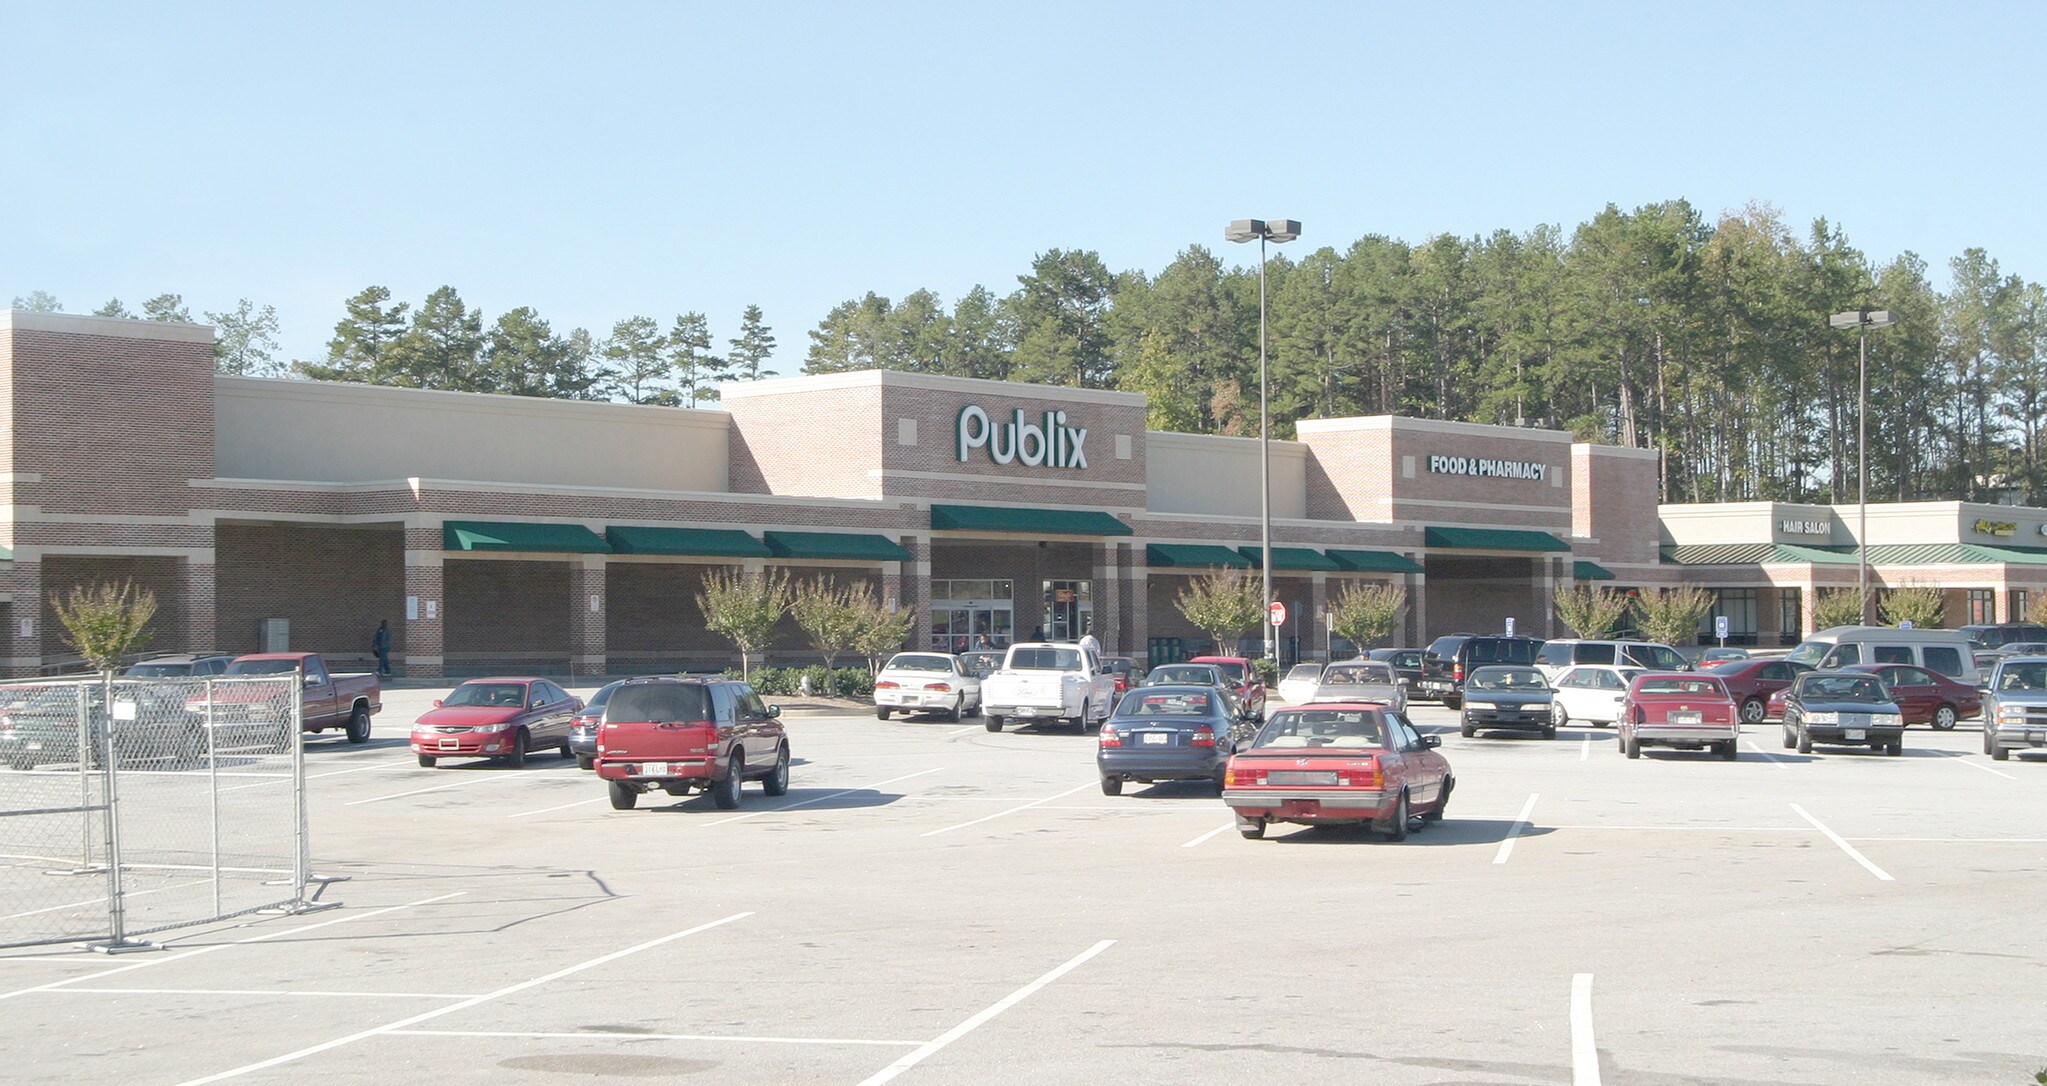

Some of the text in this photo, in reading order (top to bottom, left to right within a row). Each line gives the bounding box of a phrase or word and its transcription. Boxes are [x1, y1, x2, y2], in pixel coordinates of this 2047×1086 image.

[957, 404, 1088, 469] Publix
[1429, 455, 1546, 480] FOOD & PHARMACY
[1783, 520, 1831, 535] HAIR SALON
